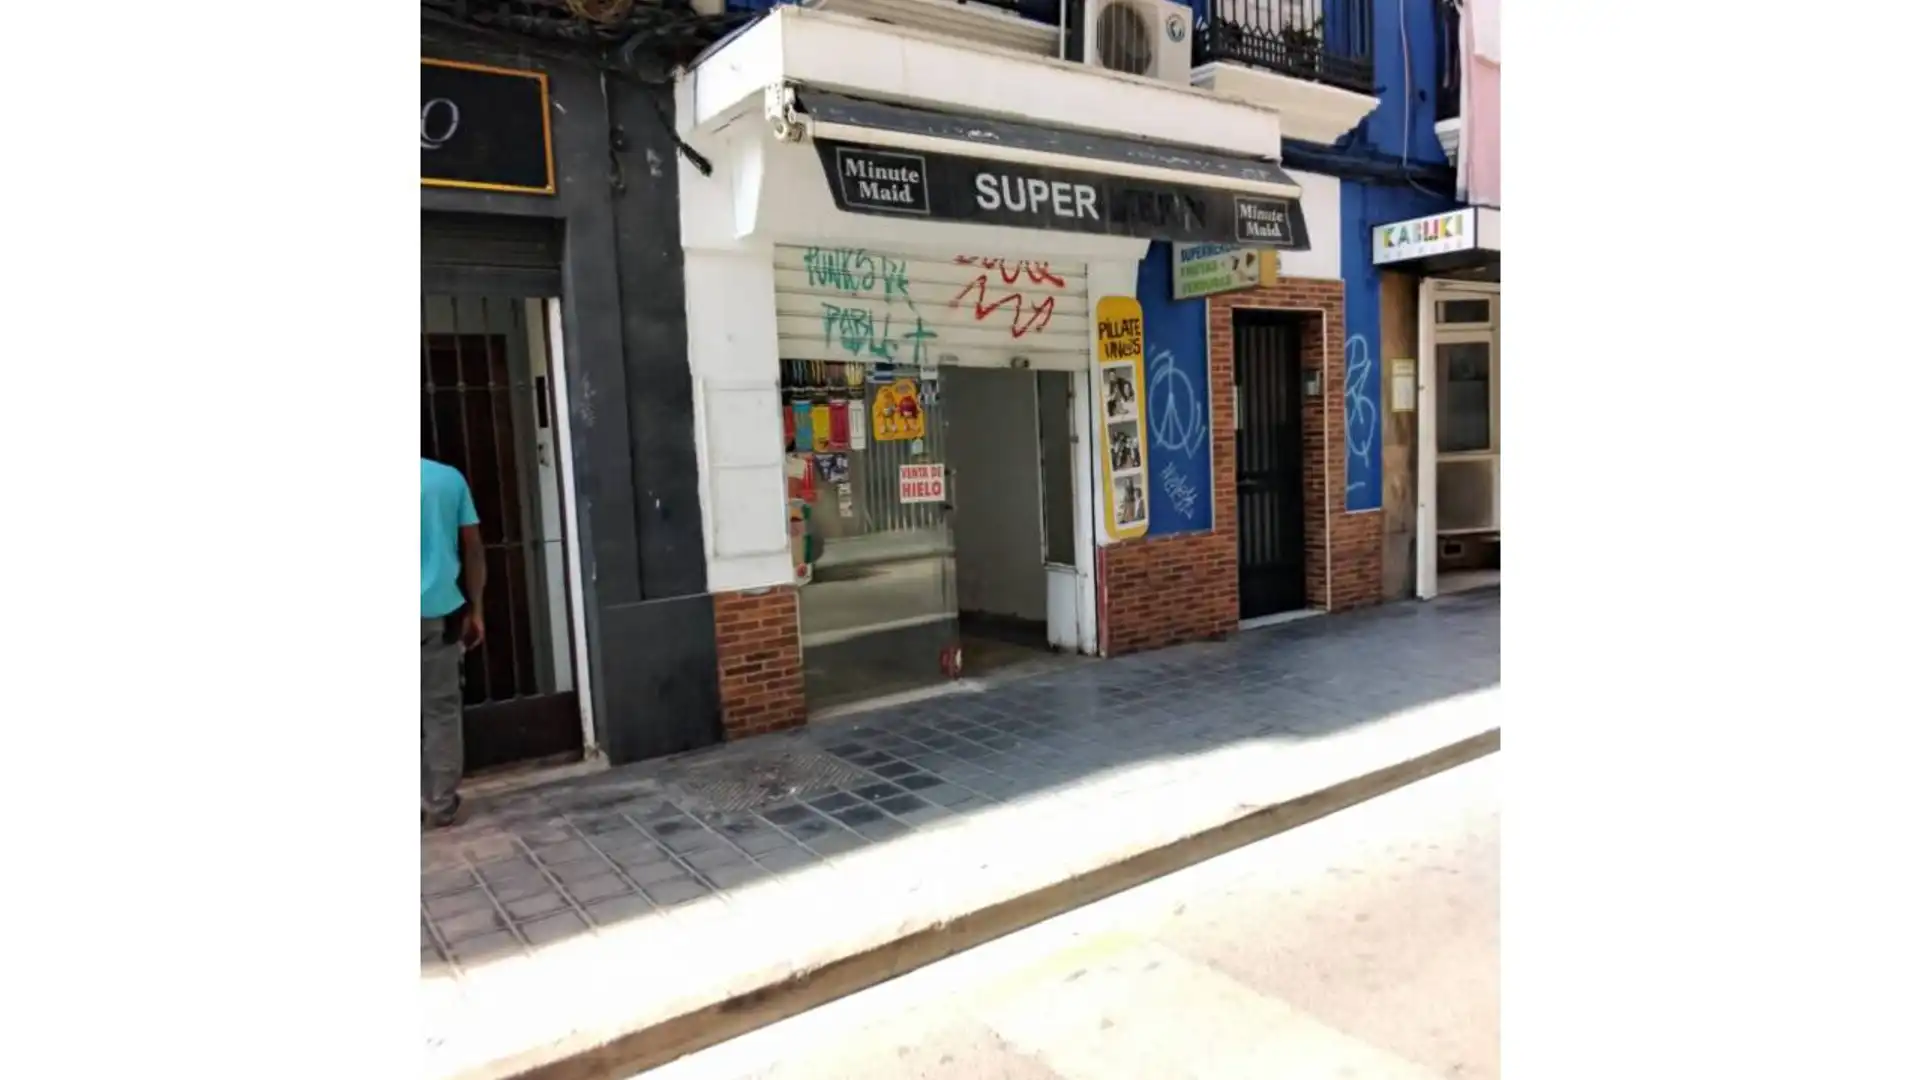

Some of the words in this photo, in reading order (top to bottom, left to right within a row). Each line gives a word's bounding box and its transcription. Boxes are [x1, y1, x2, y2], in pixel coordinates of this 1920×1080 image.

[845, 157, 920, 184] Minute
[858, 181, 915, 203] Maid
[975, 172, 1100, 220] SUPER
[1239, 203, 1284, 223] Minute
[1245, 221, 1282, 237] Maid
[902, 467, 929, 479] VENTA
[931, 466, 942, 478] DE
[902, 481, 942, 497] HIELO
